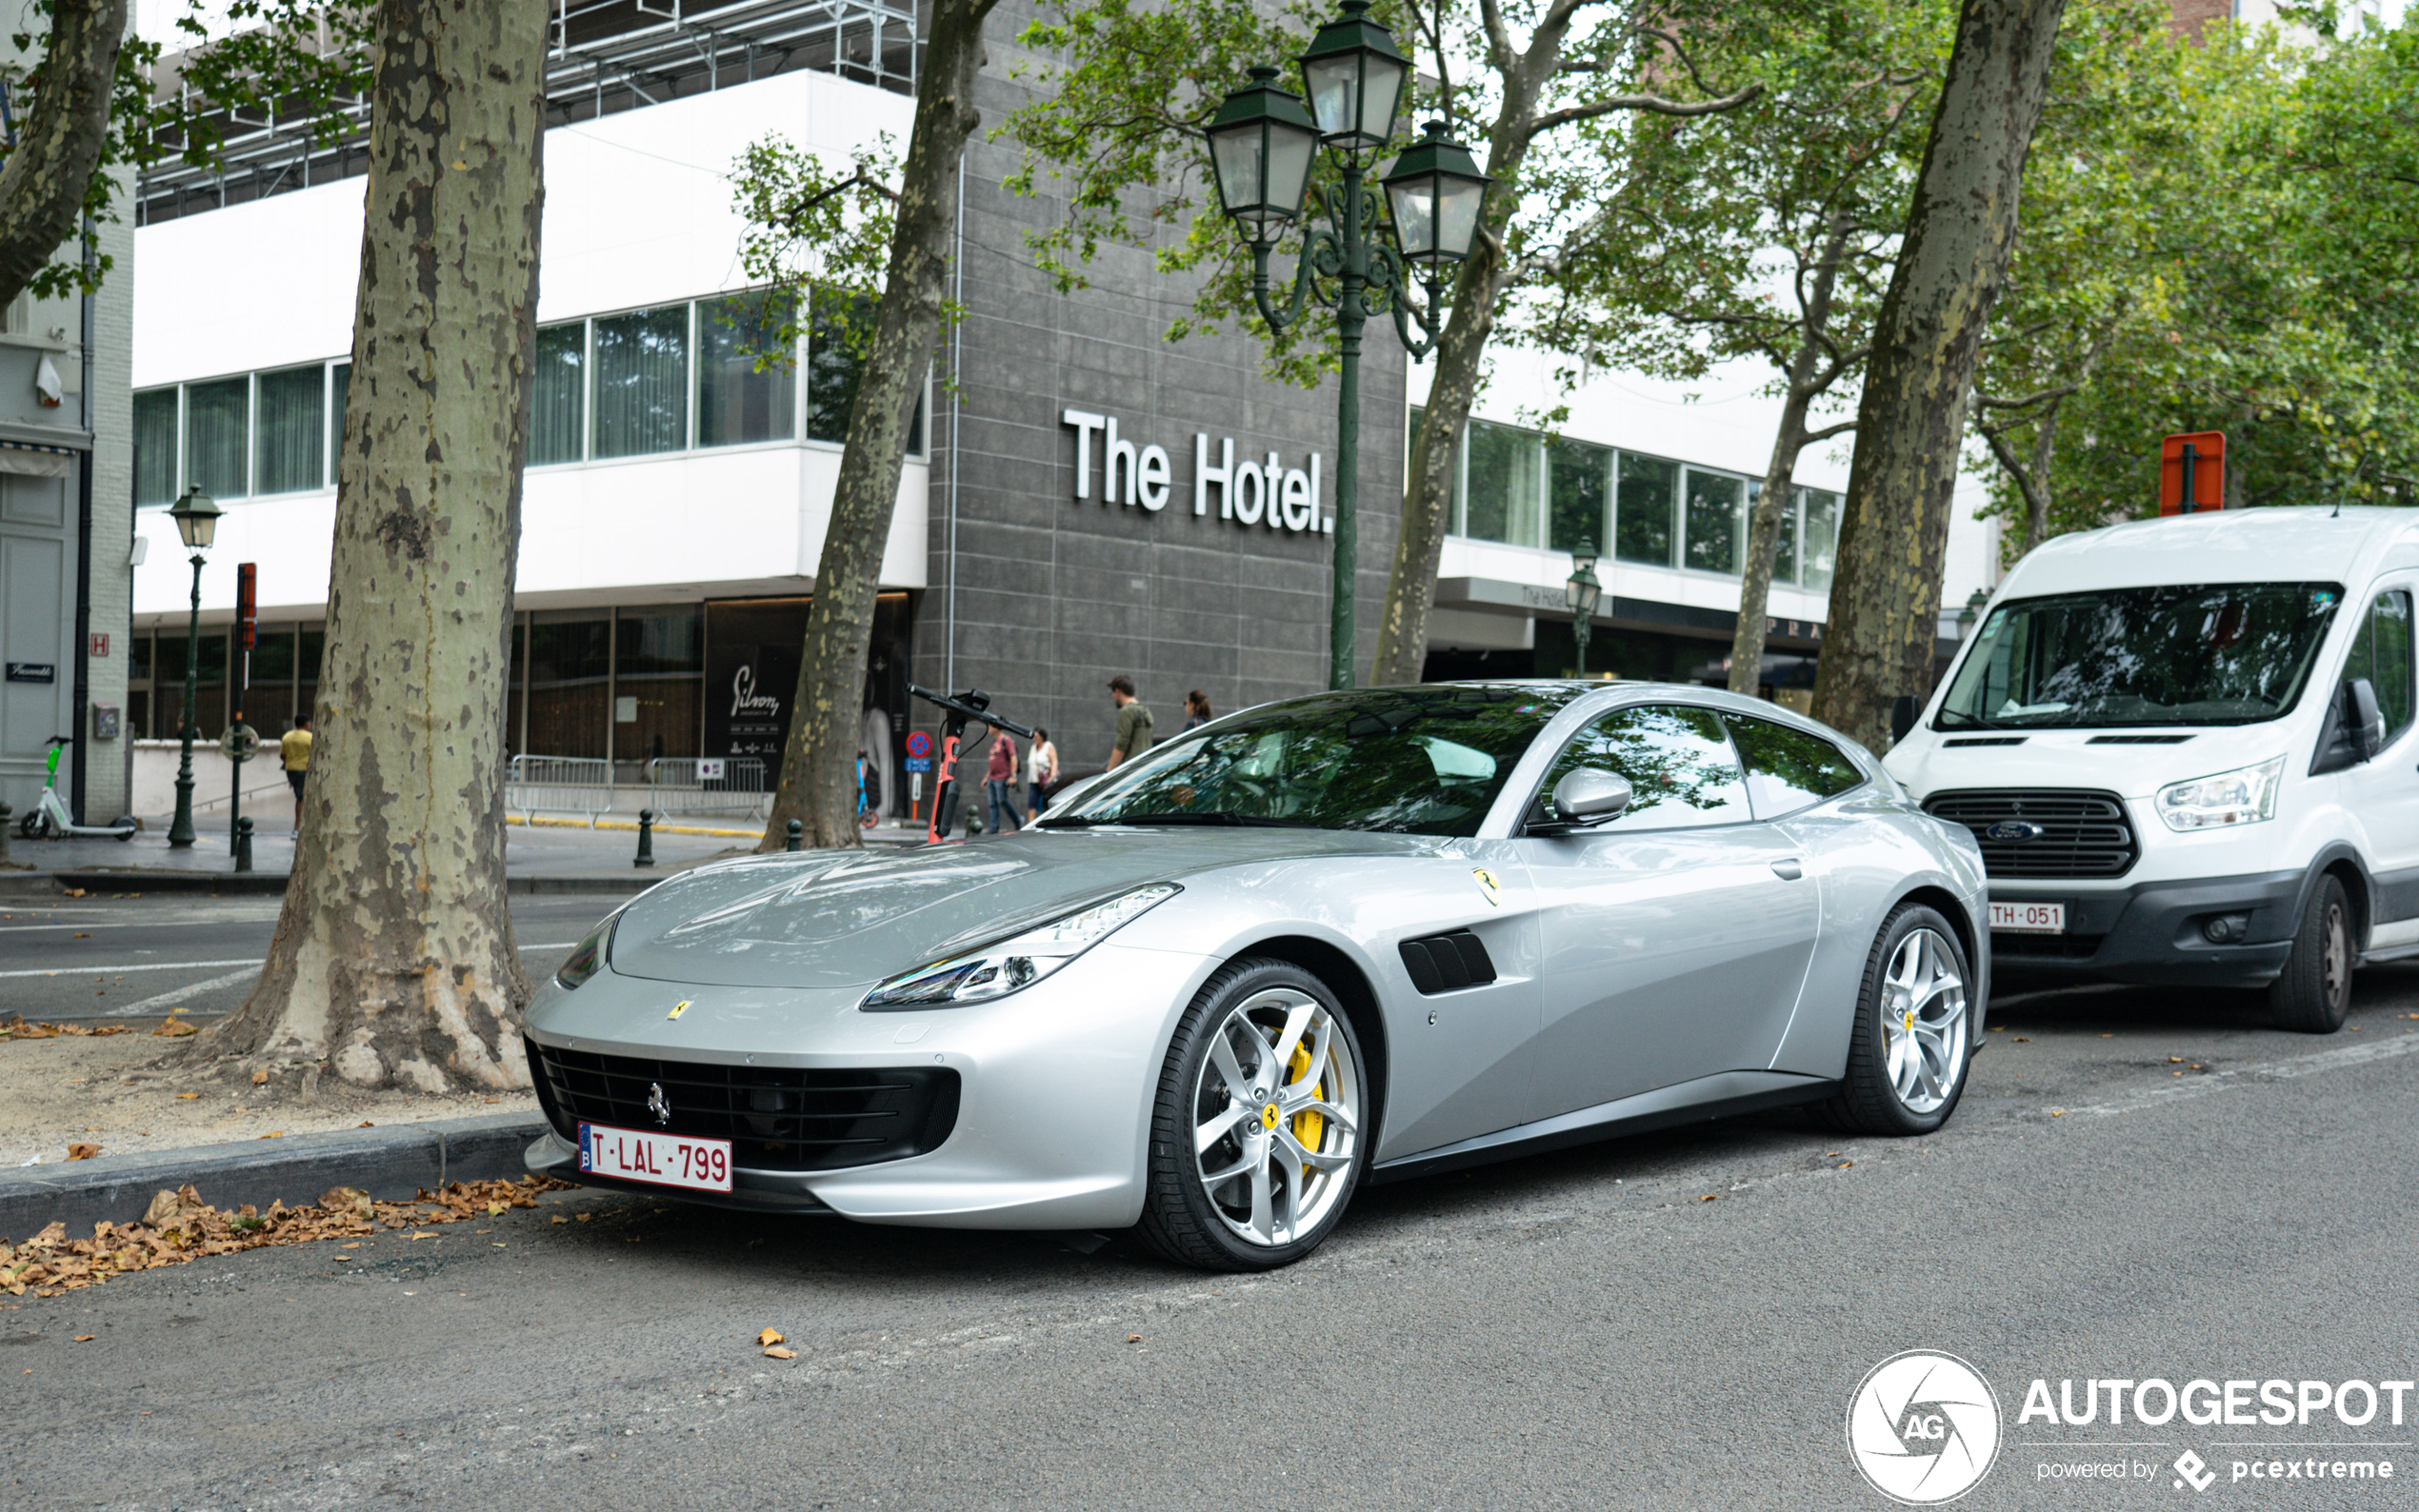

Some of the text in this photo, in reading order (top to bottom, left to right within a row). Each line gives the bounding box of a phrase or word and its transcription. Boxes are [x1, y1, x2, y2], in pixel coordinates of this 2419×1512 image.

[1064, 408, 1333, 534] The Hotel.
[1523, 586, 1540, 606] The
[93, 636, 106, 654] H
[1995, 826, 2024, 838] Ford
[1989, 905, 2060, 925] TH-051
[581, 1150, 590, 1167] B
[592, 1132, 727, 1183] T-LAL-799
